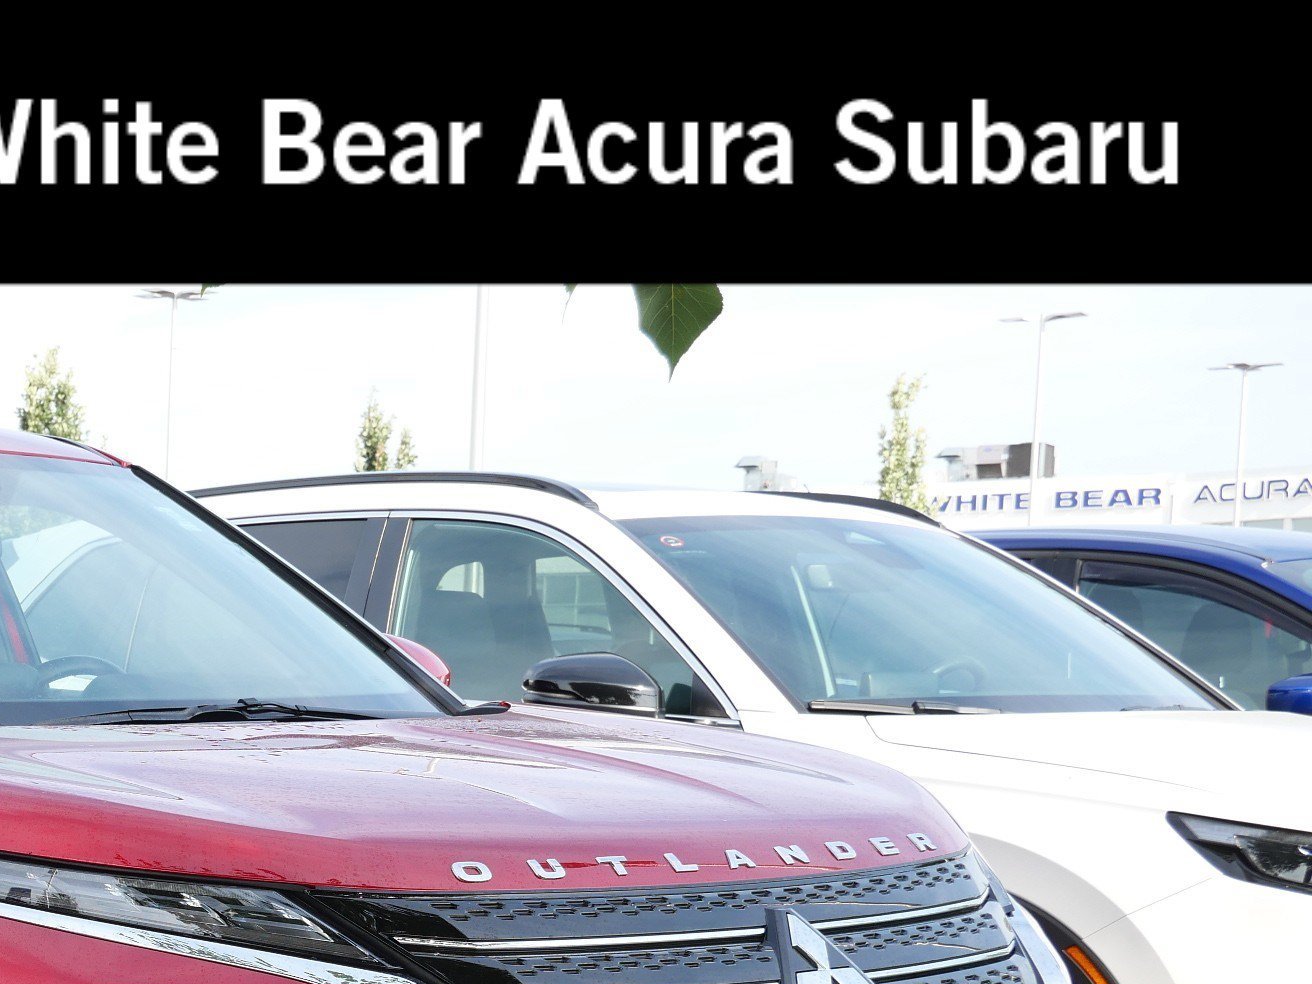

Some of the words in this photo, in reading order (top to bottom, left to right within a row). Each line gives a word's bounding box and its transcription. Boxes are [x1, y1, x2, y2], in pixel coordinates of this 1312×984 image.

[1054, 487, 1162, 509] BEAR
[1194, 477, 1312, 504] ACURA
[451, 832, 937, 882] OUTLANDER
